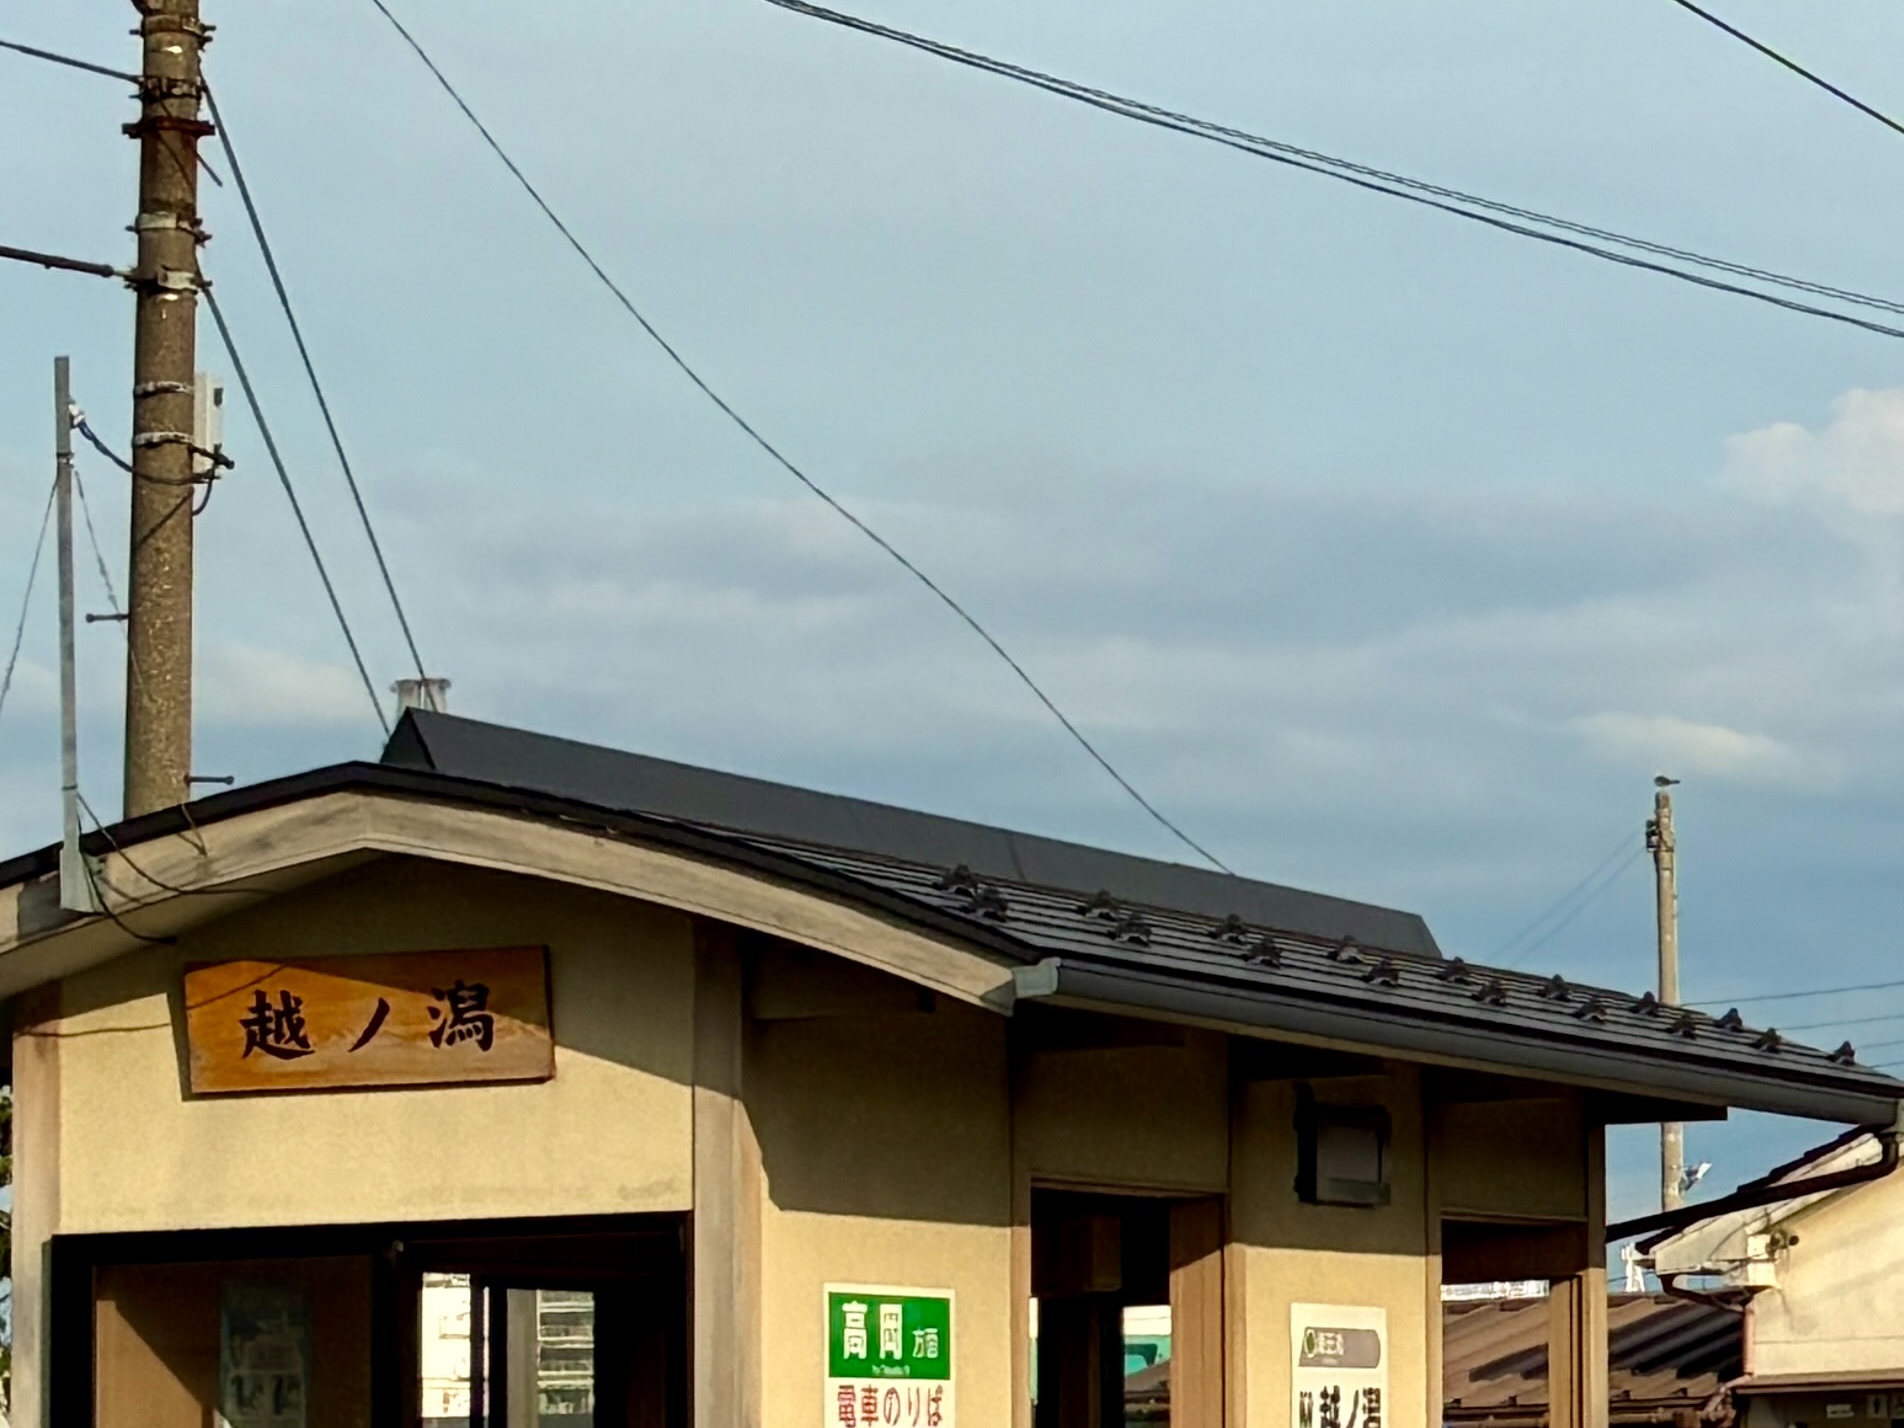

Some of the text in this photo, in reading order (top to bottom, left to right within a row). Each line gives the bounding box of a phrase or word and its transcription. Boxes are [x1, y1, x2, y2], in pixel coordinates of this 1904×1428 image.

[238, 979, 495, 1060] 越ノ潟
[837, 1384, 944, 1428] 電車のりば
